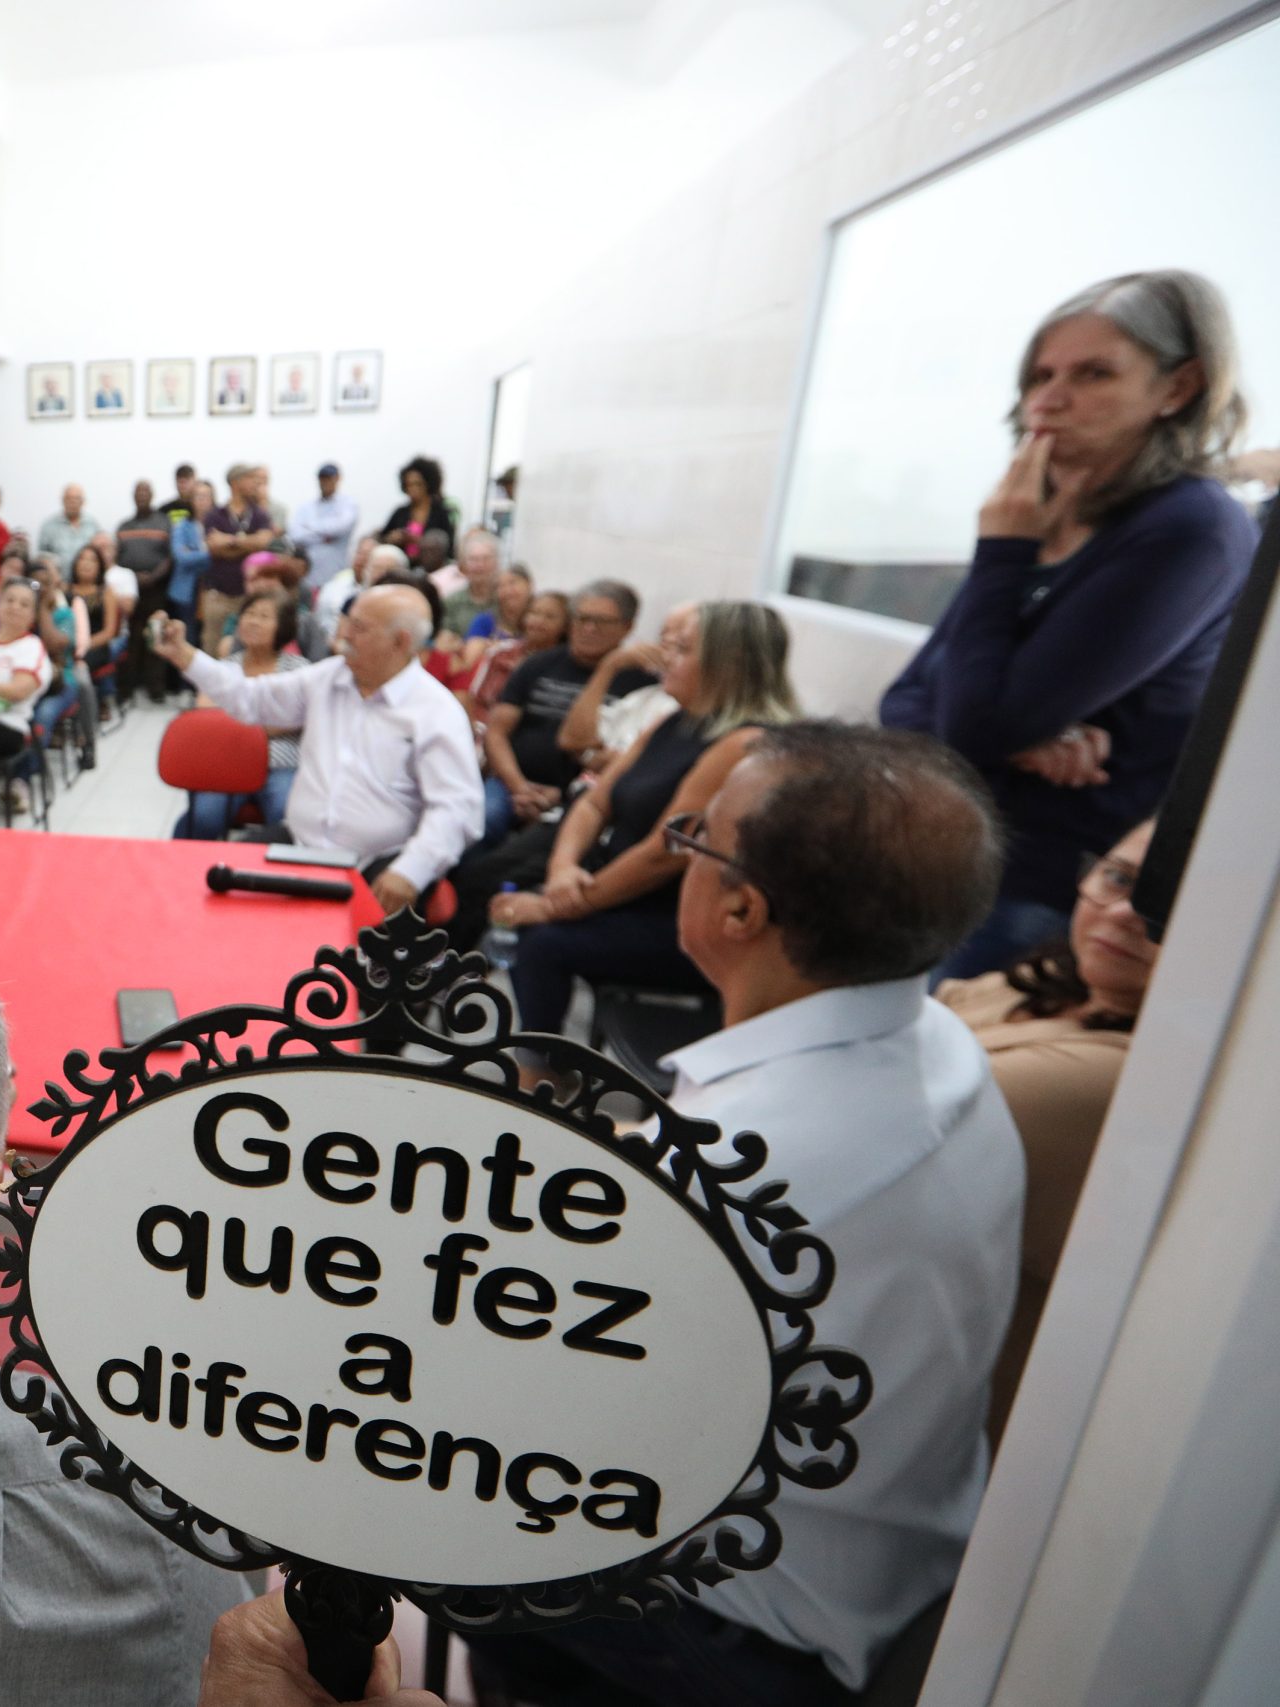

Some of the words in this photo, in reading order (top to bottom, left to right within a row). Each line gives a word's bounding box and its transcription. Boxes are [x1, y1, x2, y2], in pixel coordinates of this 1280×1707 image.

[193, 1091, 628, 1245] Gente
[136, 1204, 382, 1308] que
[422, 1232, 652, 1361] fez
[96, 1345, 662, 1540] diferença
[338, 1332, 413, 1404] a
